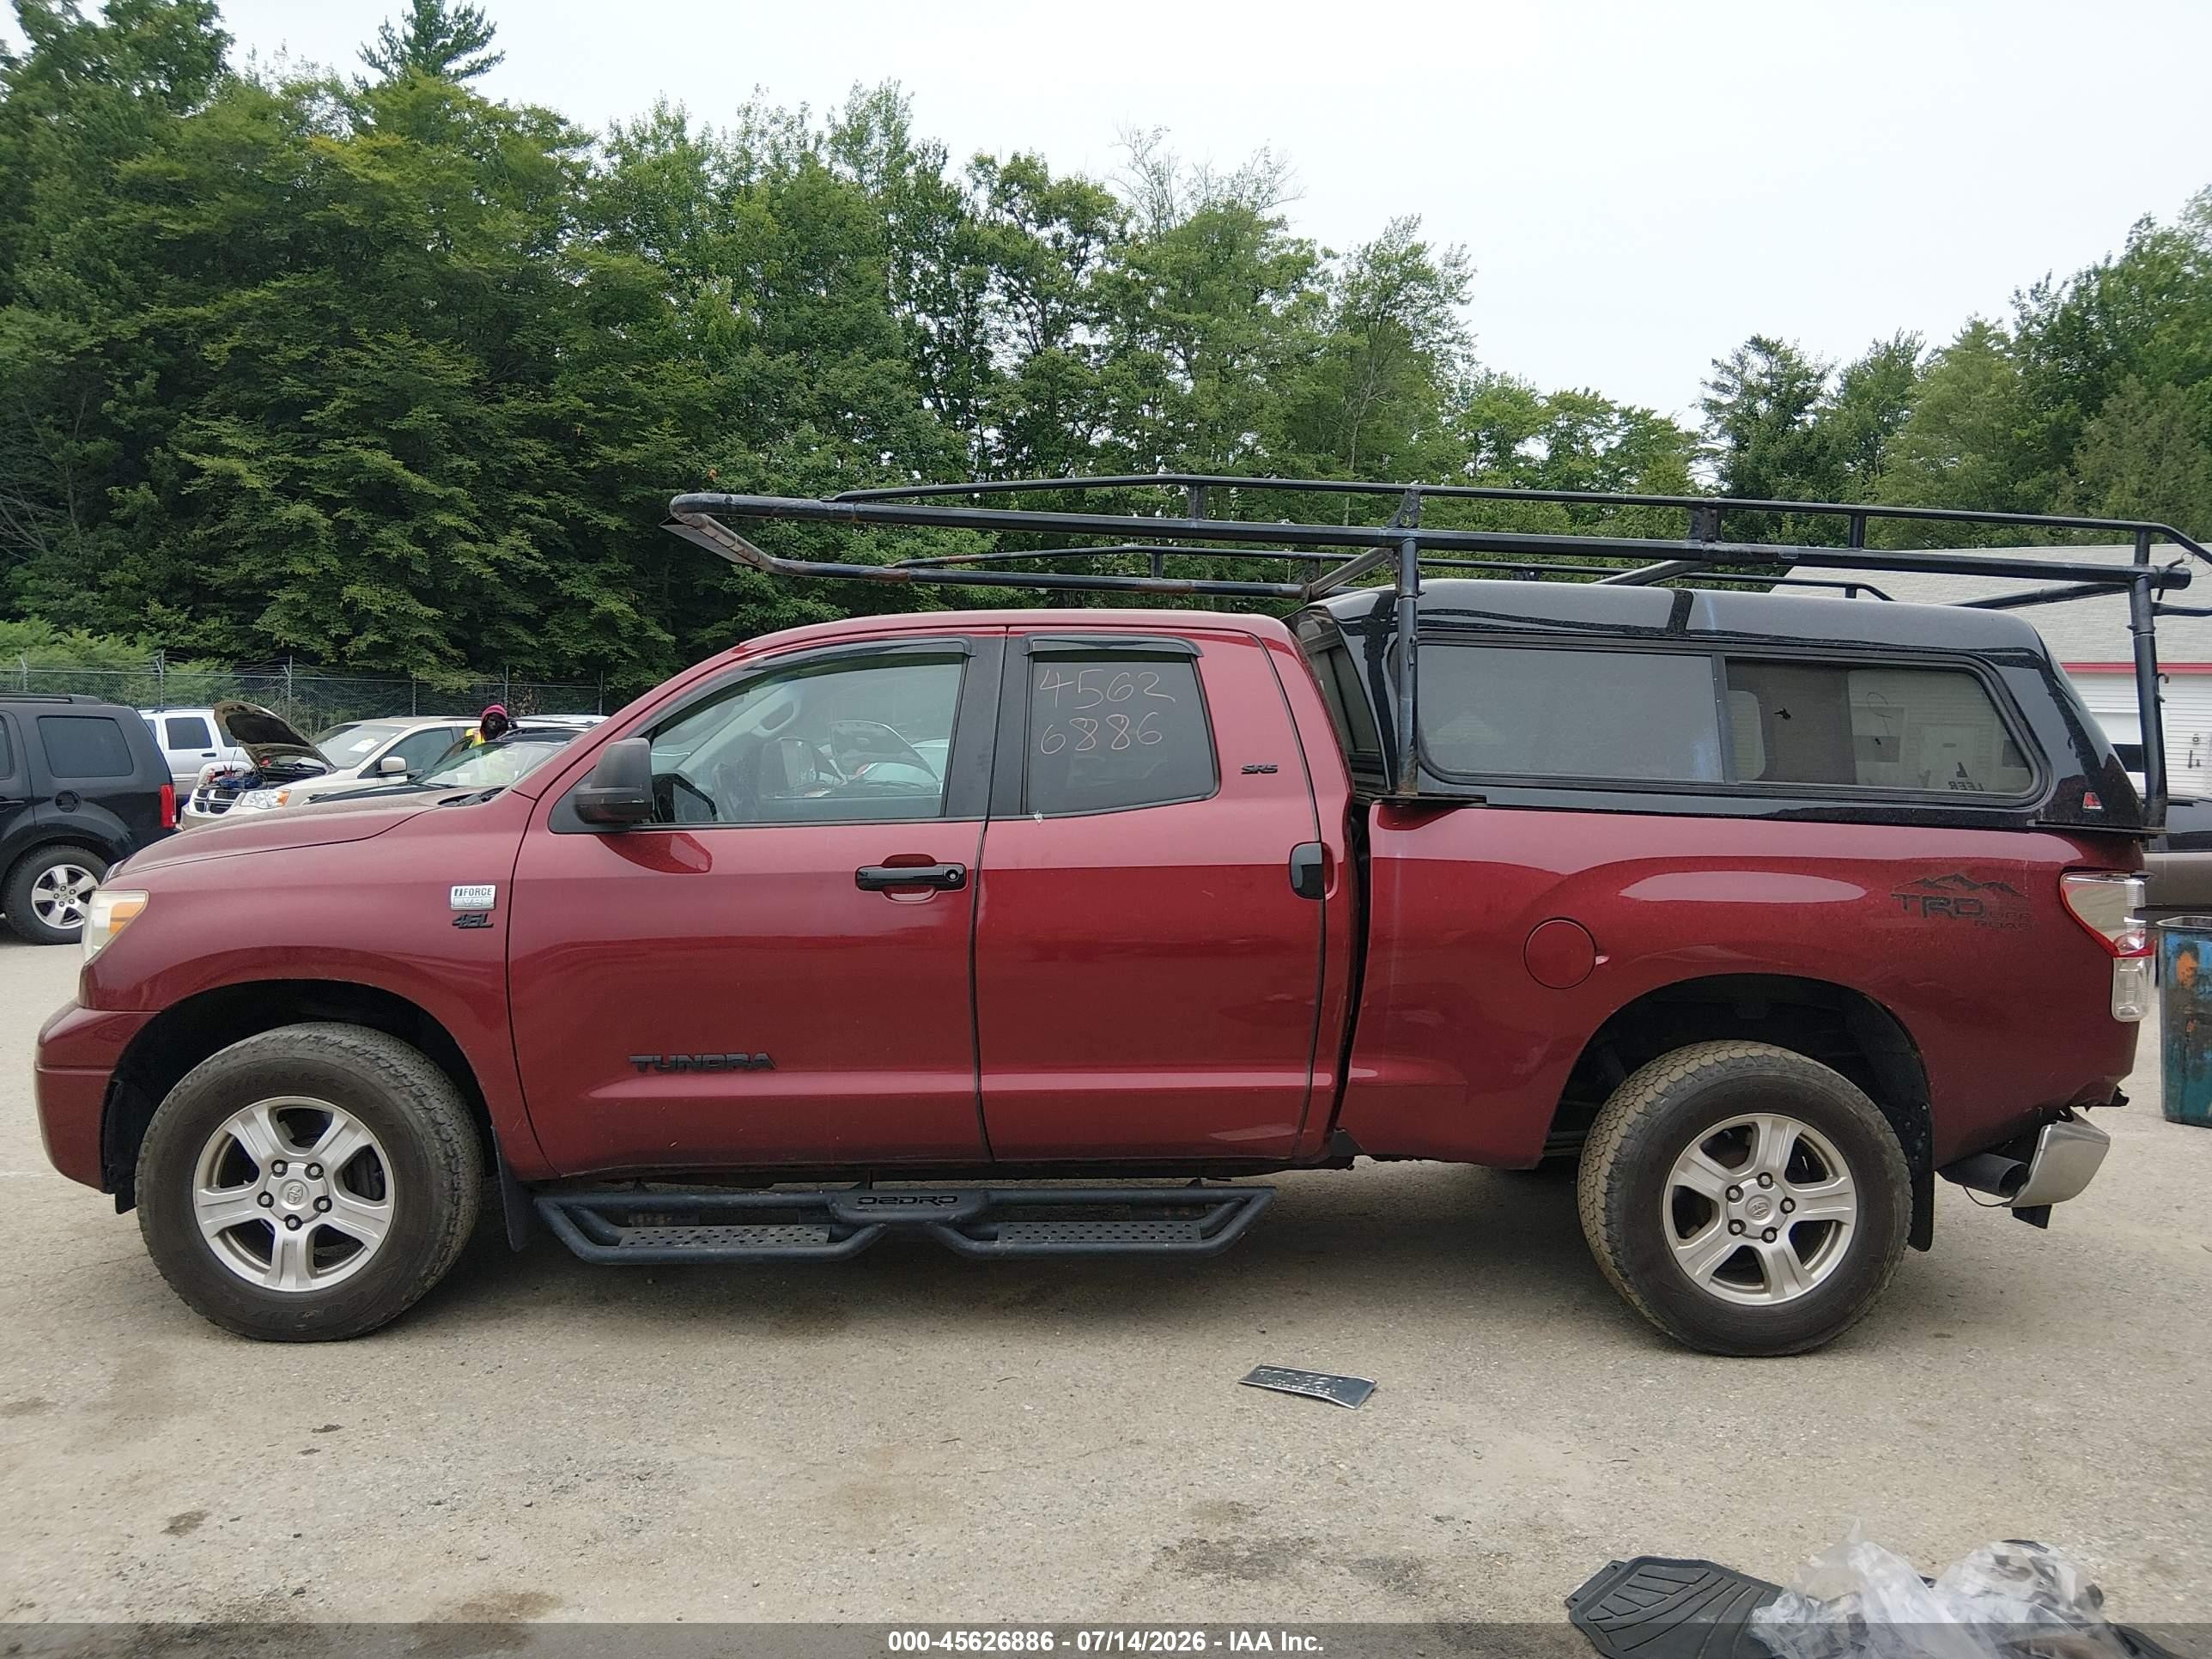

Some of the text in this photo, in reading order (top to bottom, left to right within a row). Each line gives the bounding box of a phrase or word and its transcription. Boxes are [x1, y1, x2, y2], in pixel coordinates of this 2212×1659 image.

[1039, 669, 1176, 709] 4562
[1040, 712, 1163, 754] 6886
[1241, 763, 1279, 775] SR5
[1890, 893, 1984, 920] TRD
[629, 1053, 775, 1073] TUNDRA
